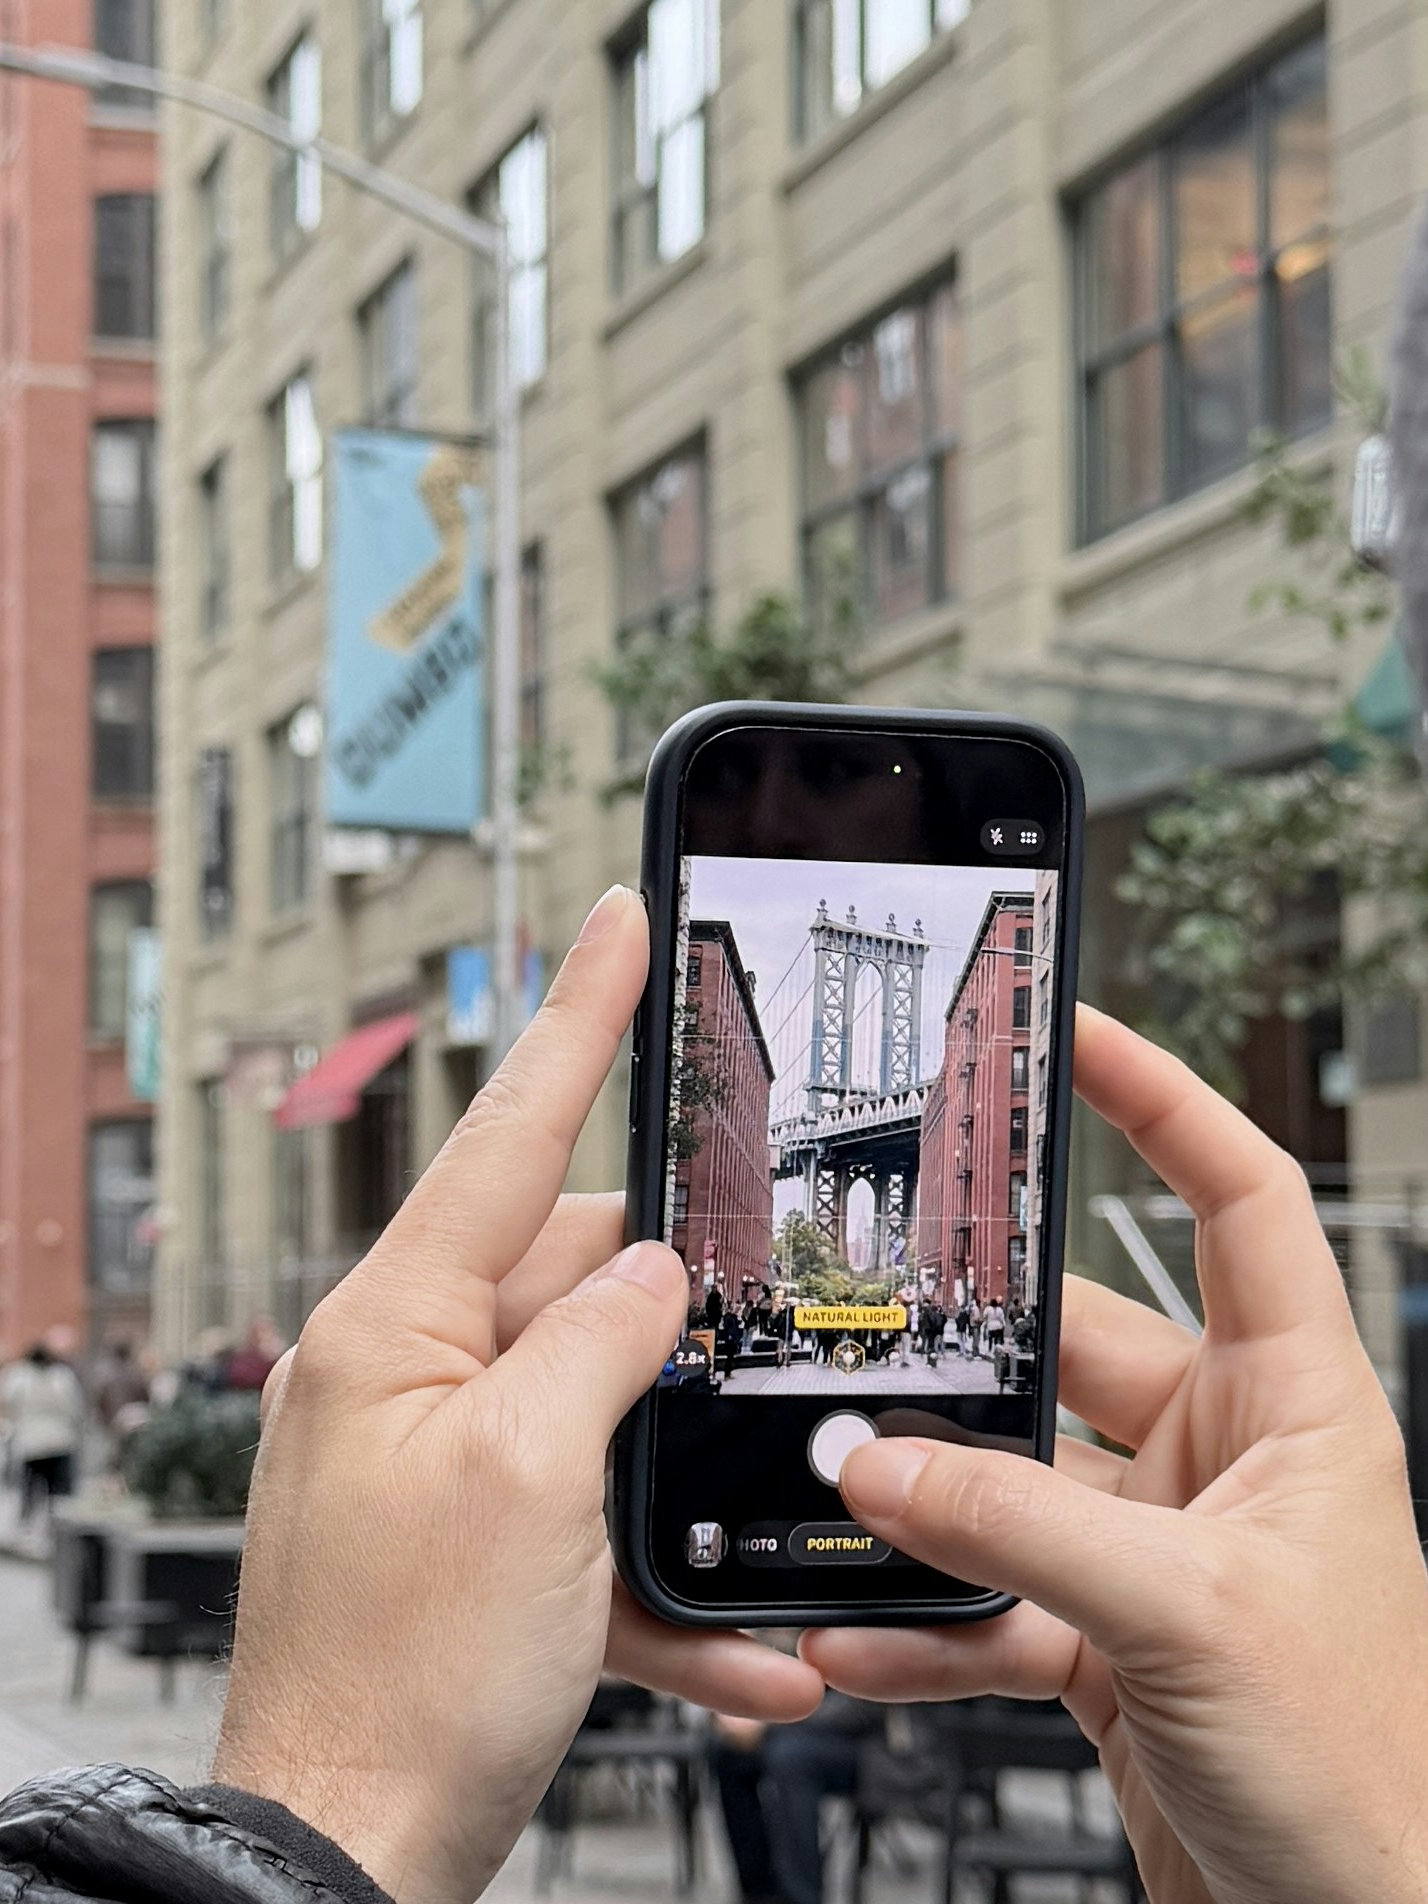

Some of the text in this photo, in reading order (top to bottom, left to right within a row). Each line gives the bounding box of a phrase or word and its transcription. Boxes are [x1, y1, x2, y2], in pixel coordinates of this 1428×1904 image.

[802, 1311, 899, 1323] NATURAL LIGHT
[737, 1537, 873, 1552] HOTO PORTRAIT
